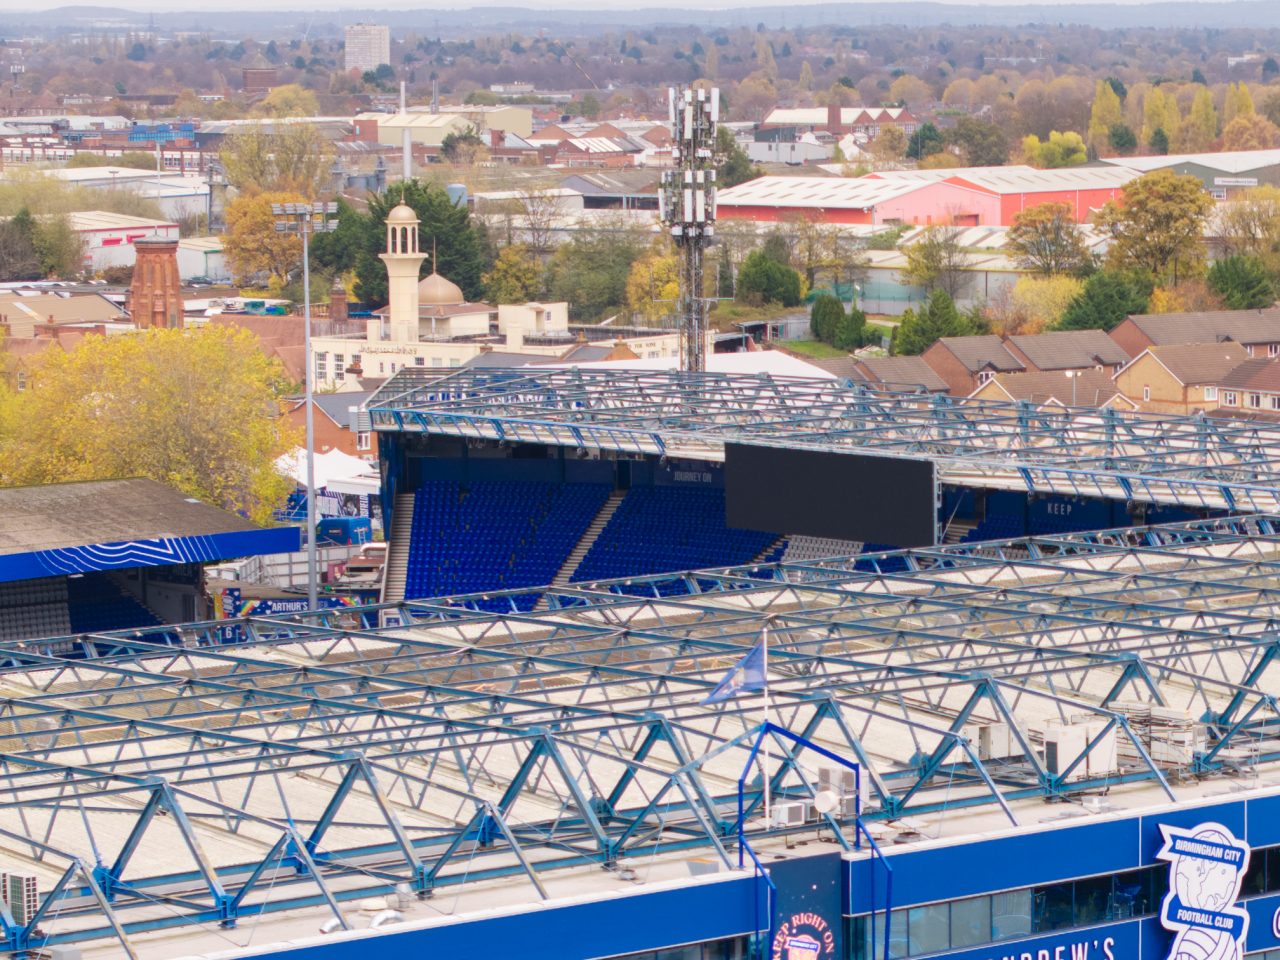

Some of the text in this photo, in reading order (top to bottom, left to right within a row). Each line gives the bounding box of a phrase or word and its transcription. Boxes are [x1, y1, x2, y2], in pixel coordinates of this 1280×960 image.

[674, 471, 713, 483] JOURNEY ON
[1047, 503, 1072, 515] KEEP
[271, 601, 308, 612] ARTHUR'S
[225, 627, 233, 639] 6
[1174, 839, 1242, 862] BIRMINGHAM CITY
[1177, 909, 1234, 930] FOOTBALL CLUB
[791, 912, 828, 932] RIGHT
[823, 930, 835, 954] ON
